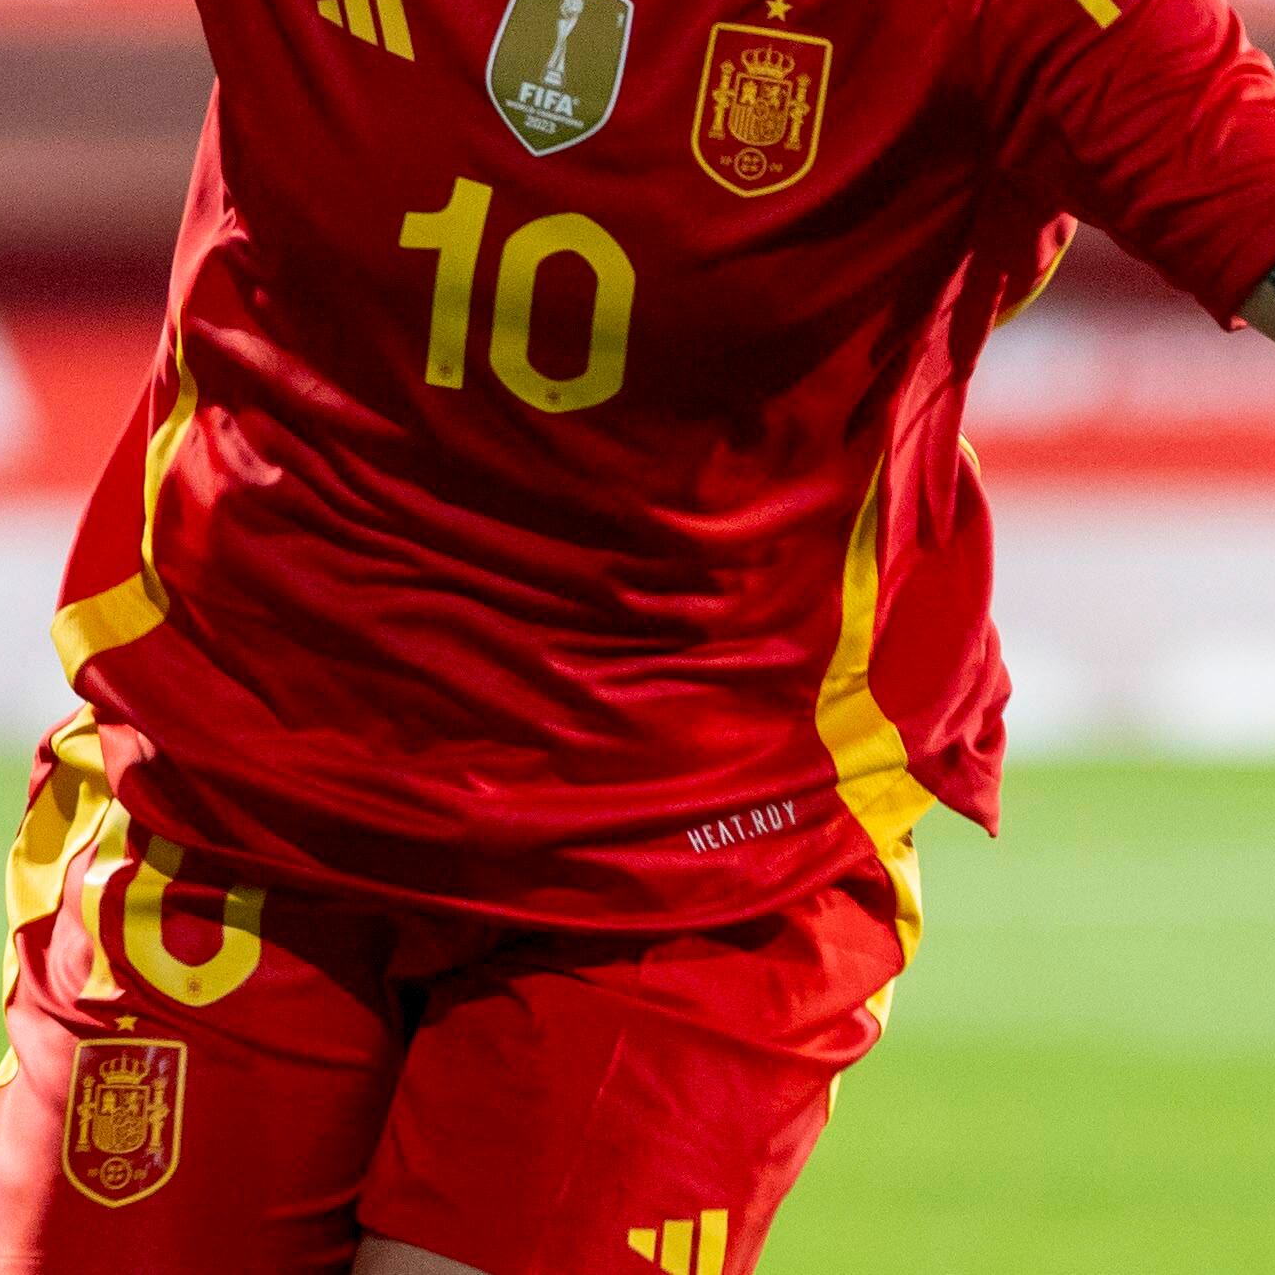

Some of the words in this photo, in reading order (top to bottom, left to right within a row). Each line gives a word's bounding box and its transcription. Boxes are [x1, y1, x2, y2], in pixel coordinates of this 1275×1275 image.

[519, 81, 574, 117] FIFA
[398, 176, 636, 414] 10
[687, 800, 796, 854] HEAT.RDY
